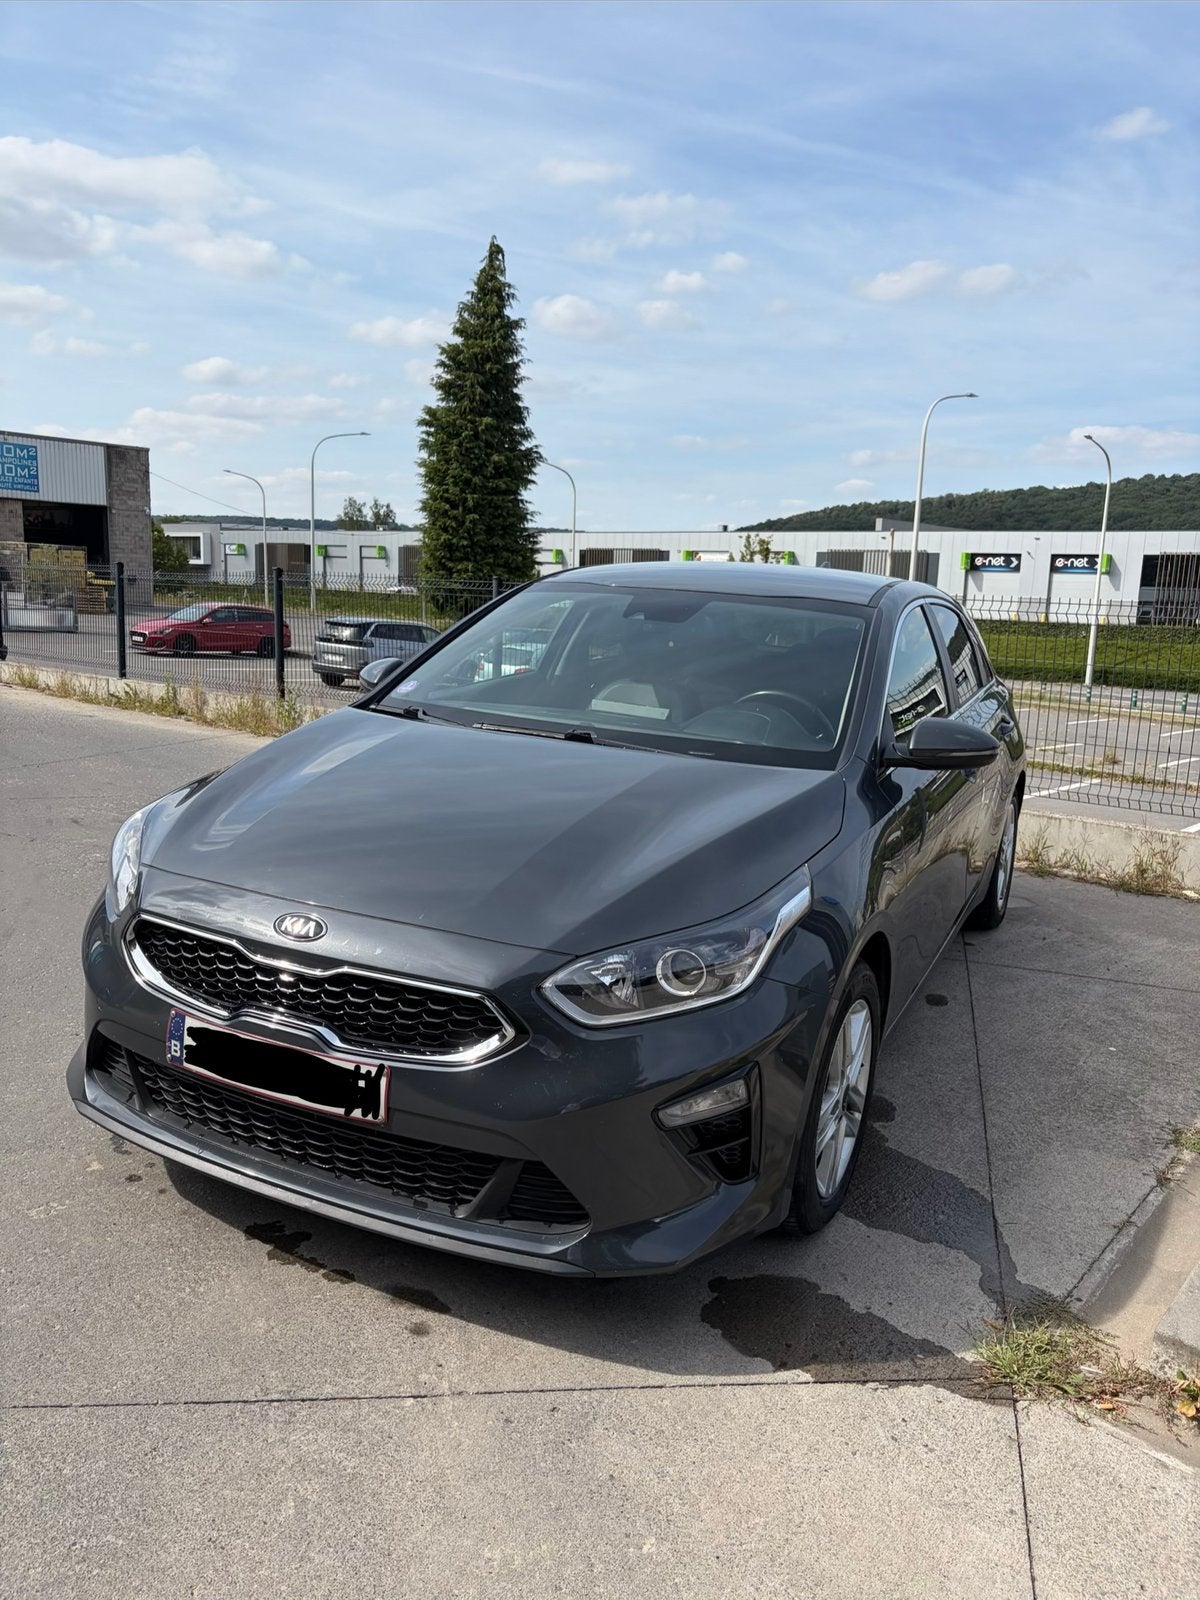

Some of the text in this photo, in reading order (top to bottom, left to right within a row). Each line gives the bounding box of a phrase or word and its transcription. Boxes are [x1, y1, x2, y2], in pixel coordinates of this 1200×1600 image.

[975, 556, 1006, 566] e-net
[1055, 557, 1090, 567] e-net
[280, 916, 316, 937] KIA
[171, 1039, 181, 1057] B
